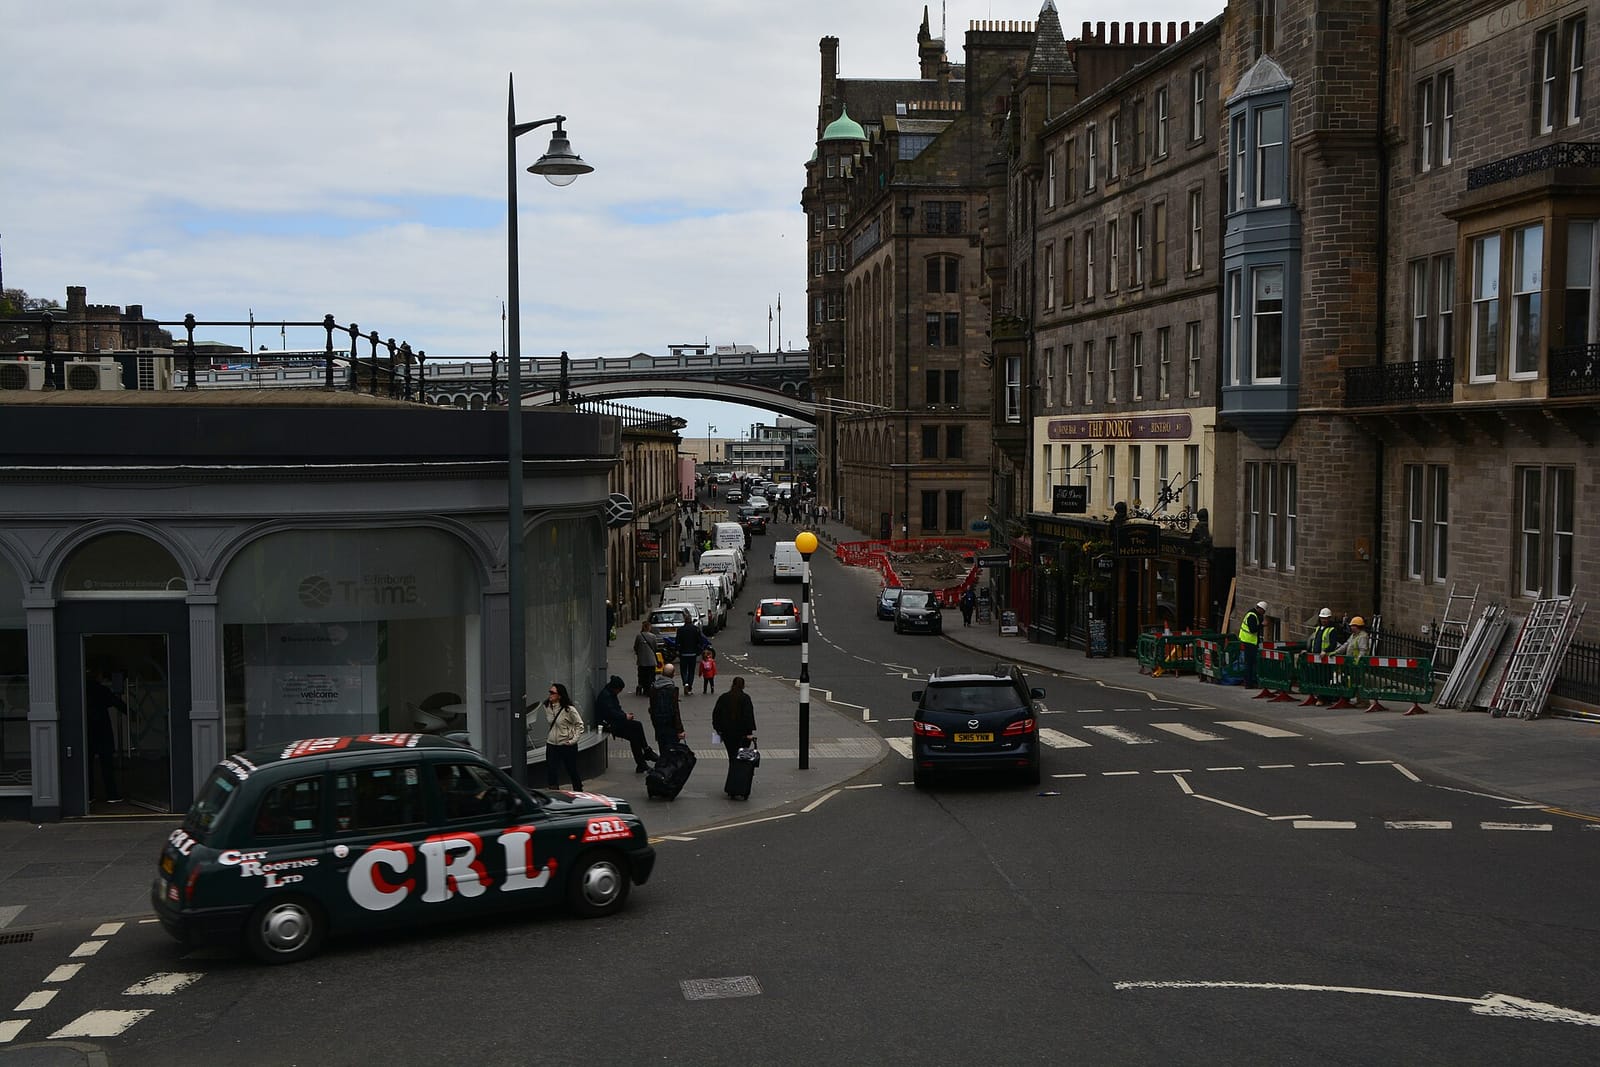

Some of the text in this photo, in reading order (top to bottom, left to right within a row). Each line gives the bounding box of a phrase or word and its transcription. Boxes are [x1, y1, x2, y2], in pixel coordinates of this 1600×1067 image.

[1088, 419, 1133, 438] THE DORIC
[365, 575, 417, 586] Edinburgh
[301, 689, 340, 698] welcome
[589, 820, 625, 835] CRL
[347, 825, 559, 911] CRL
